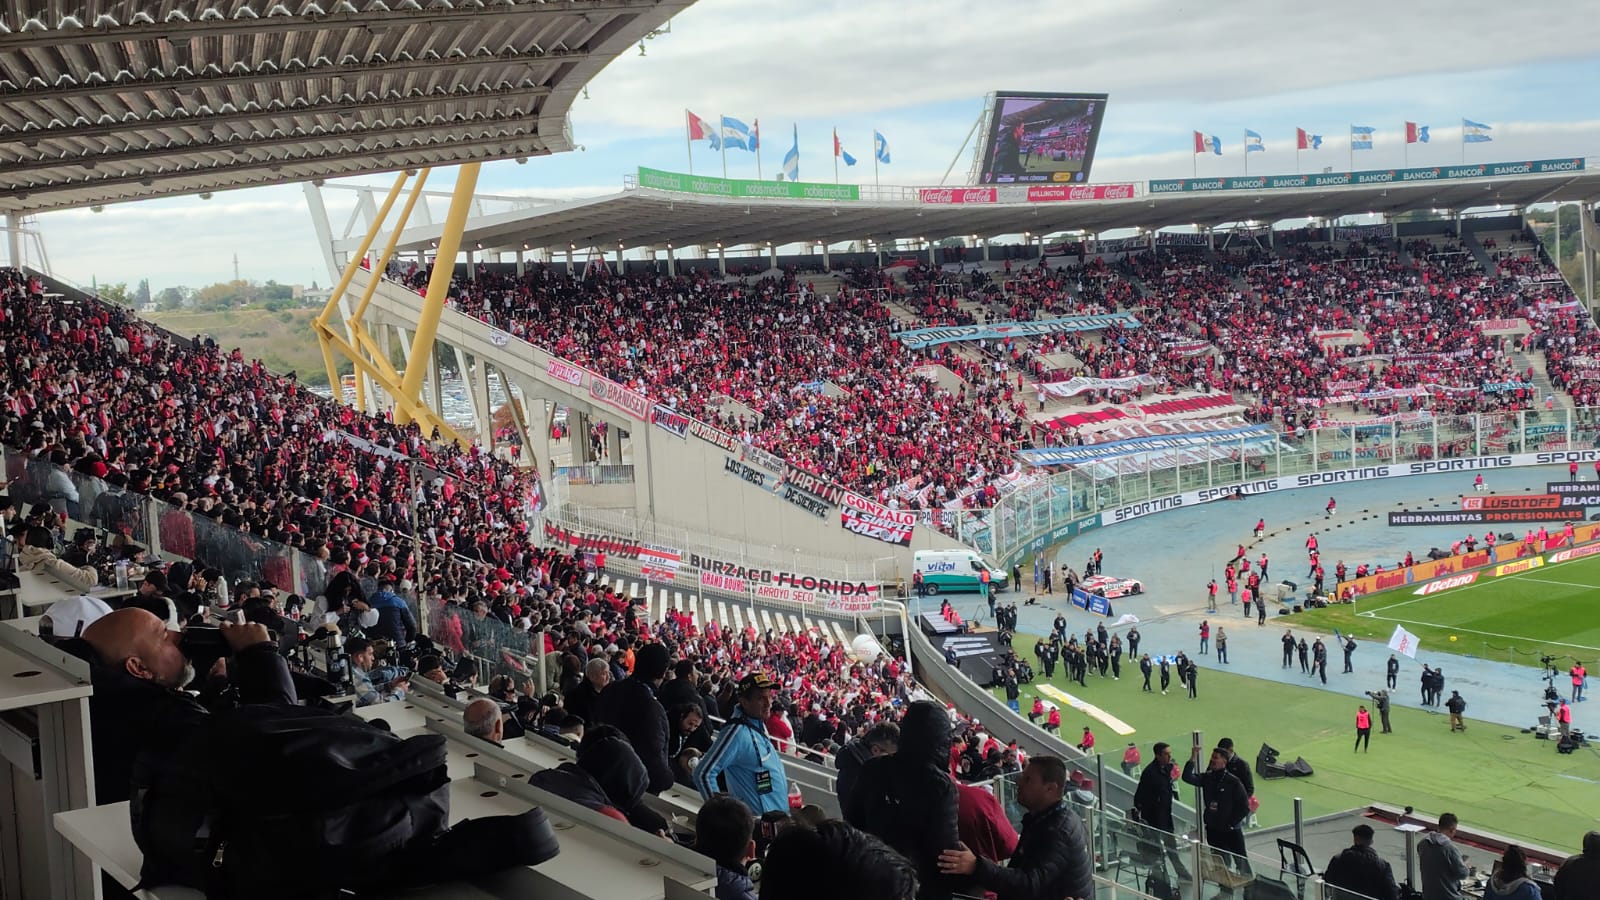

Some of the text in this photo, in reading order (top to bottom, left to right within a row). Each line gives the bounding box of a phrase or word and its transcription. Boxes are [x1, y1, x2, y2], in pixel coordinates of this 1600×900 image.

[1448, 169, 1483, 178] BANCOR
[1494, 165, 1530, 175] BANCOR
[1541, 163, 1577, 171] BANCOR
[1273, 178, 1306, 187] BANCOR
[1316, 176, 1349, 185] BANCOR
[1359, 174, 1393, 182] BANCOR
[1403, 172, 1438, 180] BANCOR
[1153, 184, 1183, 192] BANCOR
[1192, 182, 1223, 190] BANCOR
[1232, 180, 1264, 189] BANCOR
[1030, 190, 1064, 198] WILLINGTON
[607, 384, 646, 416] BRANDSEN
[1525, 426, 1567, 435] CASILD
[1333, 449, 1375, 460] RINON
[1536, 451, 1600, 465] SPOR
[725, 456, 740, 473] LOS
[741, 464, 765, 487] PIBES
[1410, 456, 1512, 474] SPORTING
[1297, 466, 1389, 486] SPORTING
[1198, 479, 1279, 502] SPORTING
[846, 494, 914, 526] GONZALO
[1115, 495, 1182, 521] SPORTING
[842, 507, 913, 533] LA SIMPLE
[922, 511, 953, 524] PACHECO
[1392, 510, 1583, 523] HERRAMIENTAS PROFESIONALES
[544, 519, 641, 560] SAN MIGUEL
[1462, 553, 1488, 569] Quini
[1503, 561, 1529, 575] Quini
[690, 554, 771, 583] BURZACO
[702, 572, 744, 593] GRAND BOURG
[779, 572, 869, 596] FLORIDA
[1376, 571, 1404, 590] Quini
[1429, 574, 1473, 593] Betano
[758, 586, 814, 603] ARROYO SECO
[844, 603, 860, 611] CADA
